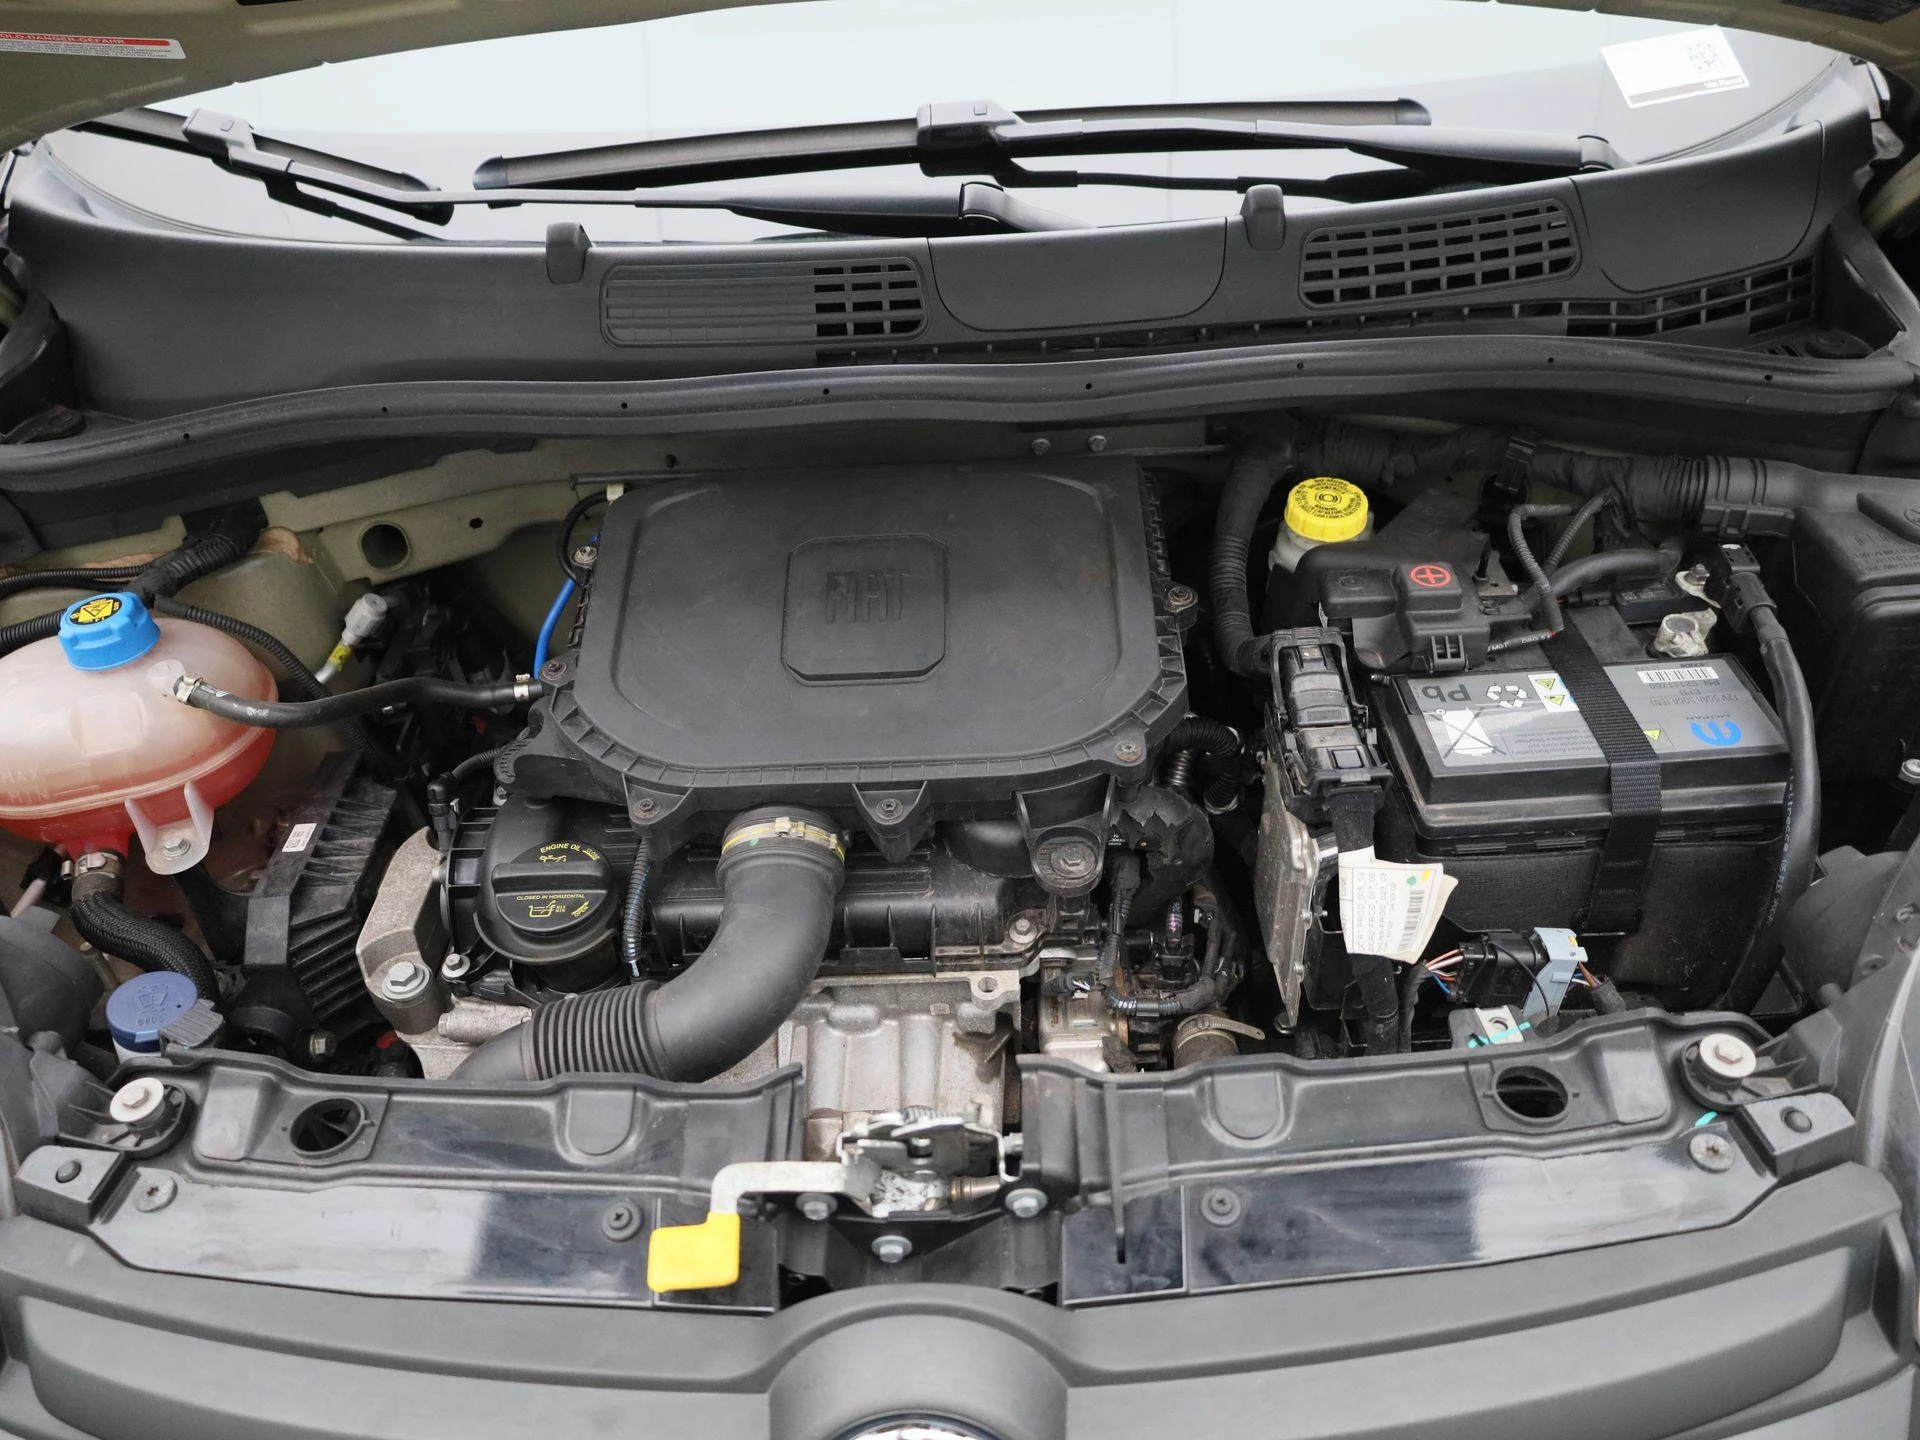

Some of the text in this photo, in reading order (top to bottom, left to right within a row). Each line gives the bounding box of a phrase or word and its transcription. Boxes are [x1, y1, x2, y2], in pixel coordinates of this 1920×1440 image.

[825, 569, 912, 624] FIAT
[1421, 683, 1472, 703] Pb
[1721, 693, 1739, 702] 12V
[540, 842, 581, 854] ENGINE OIL
[1775, 875, 1785, 894] FLEX
[574, 905, 589, 918] OPEN
